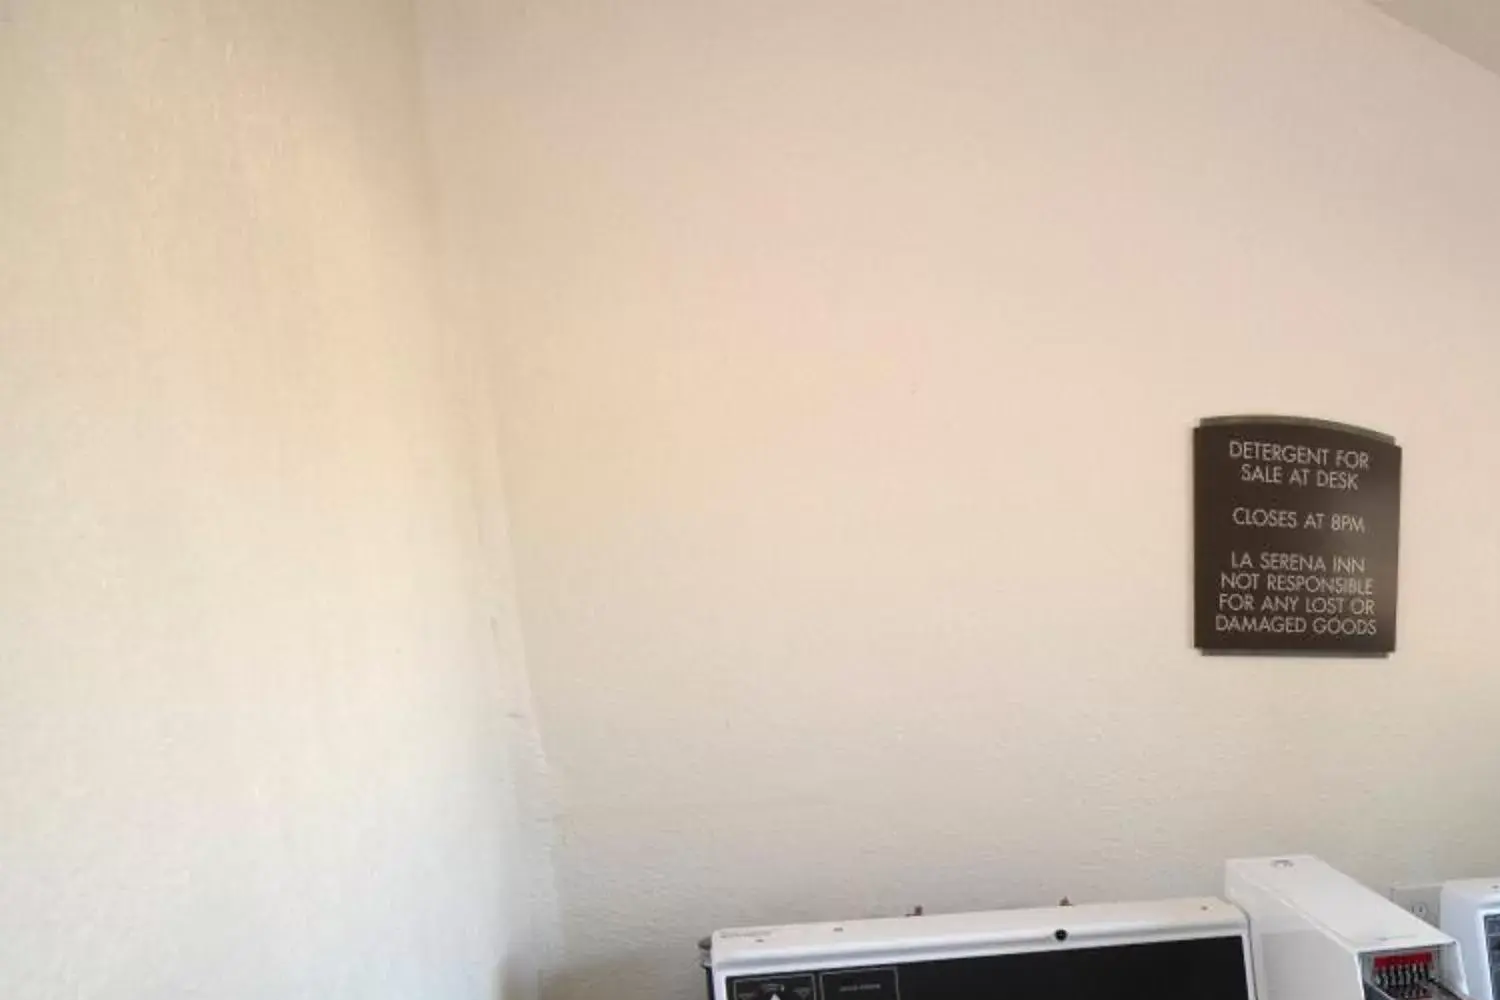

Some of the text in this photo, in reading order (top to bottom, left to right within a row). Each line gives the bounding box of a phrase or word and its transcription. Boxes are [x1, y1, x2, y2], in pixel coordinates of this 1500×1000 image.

[1229, 440, 1369, 469] DETERGENT FOR
[1241, 465, 1359, 491] SALE AT DESK
[1232, 507, 1366, 533] CLOSES AT 8PM
[1231, 551, 1365, 573] LA SERENA INN
[1221, 572, 1374, 596] NOT RESPONSIBLE
[1219, 593, 1376, 616] FOR ANY LOST OR
[1215, 615, 1377, 636] DAMAGED GOODS
